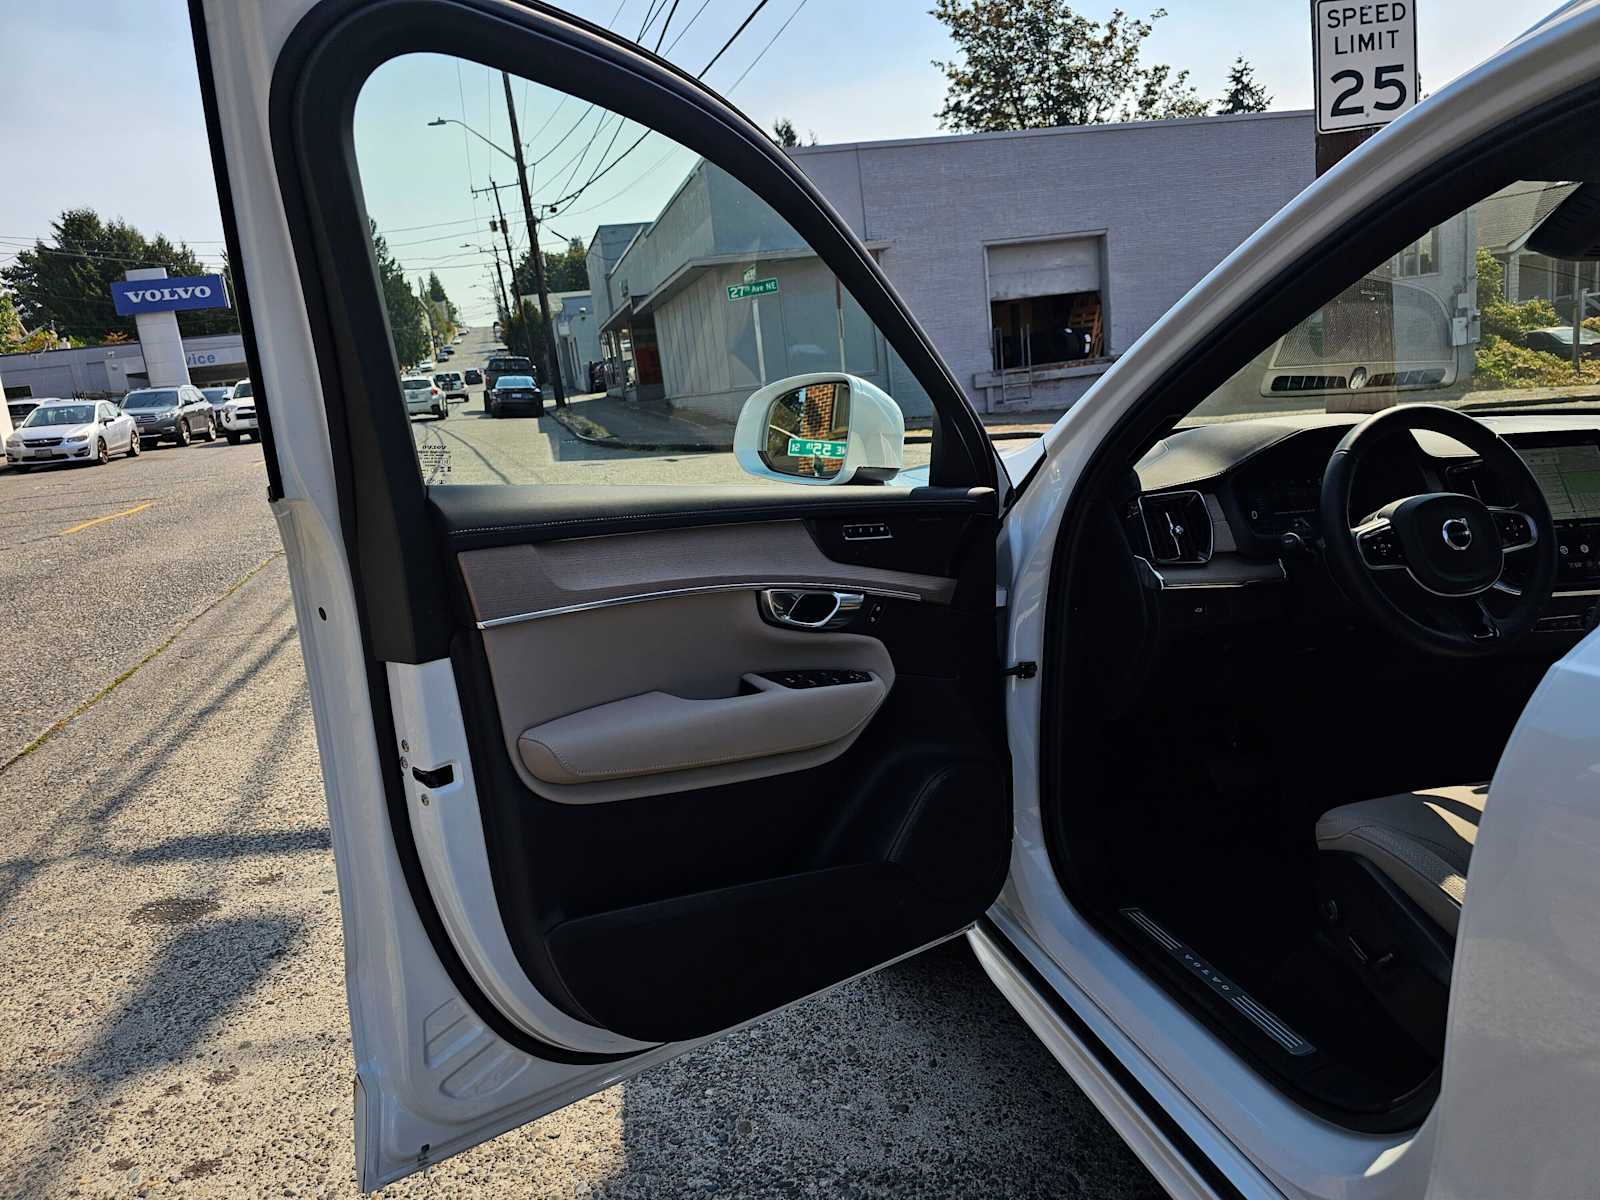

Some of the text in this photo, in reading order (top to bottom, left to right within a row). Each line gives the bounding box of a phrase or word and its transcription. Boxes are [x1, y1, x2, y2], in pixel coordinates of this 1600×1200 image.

[1327, 2, 1406, 28] SPEED
[1334, 30, 1399, 55] LIMIT
[1330, 64, 1407, 117] 25
[124, 286, 212, 304] VOLVO
[766, 282, 776, 290] NE
